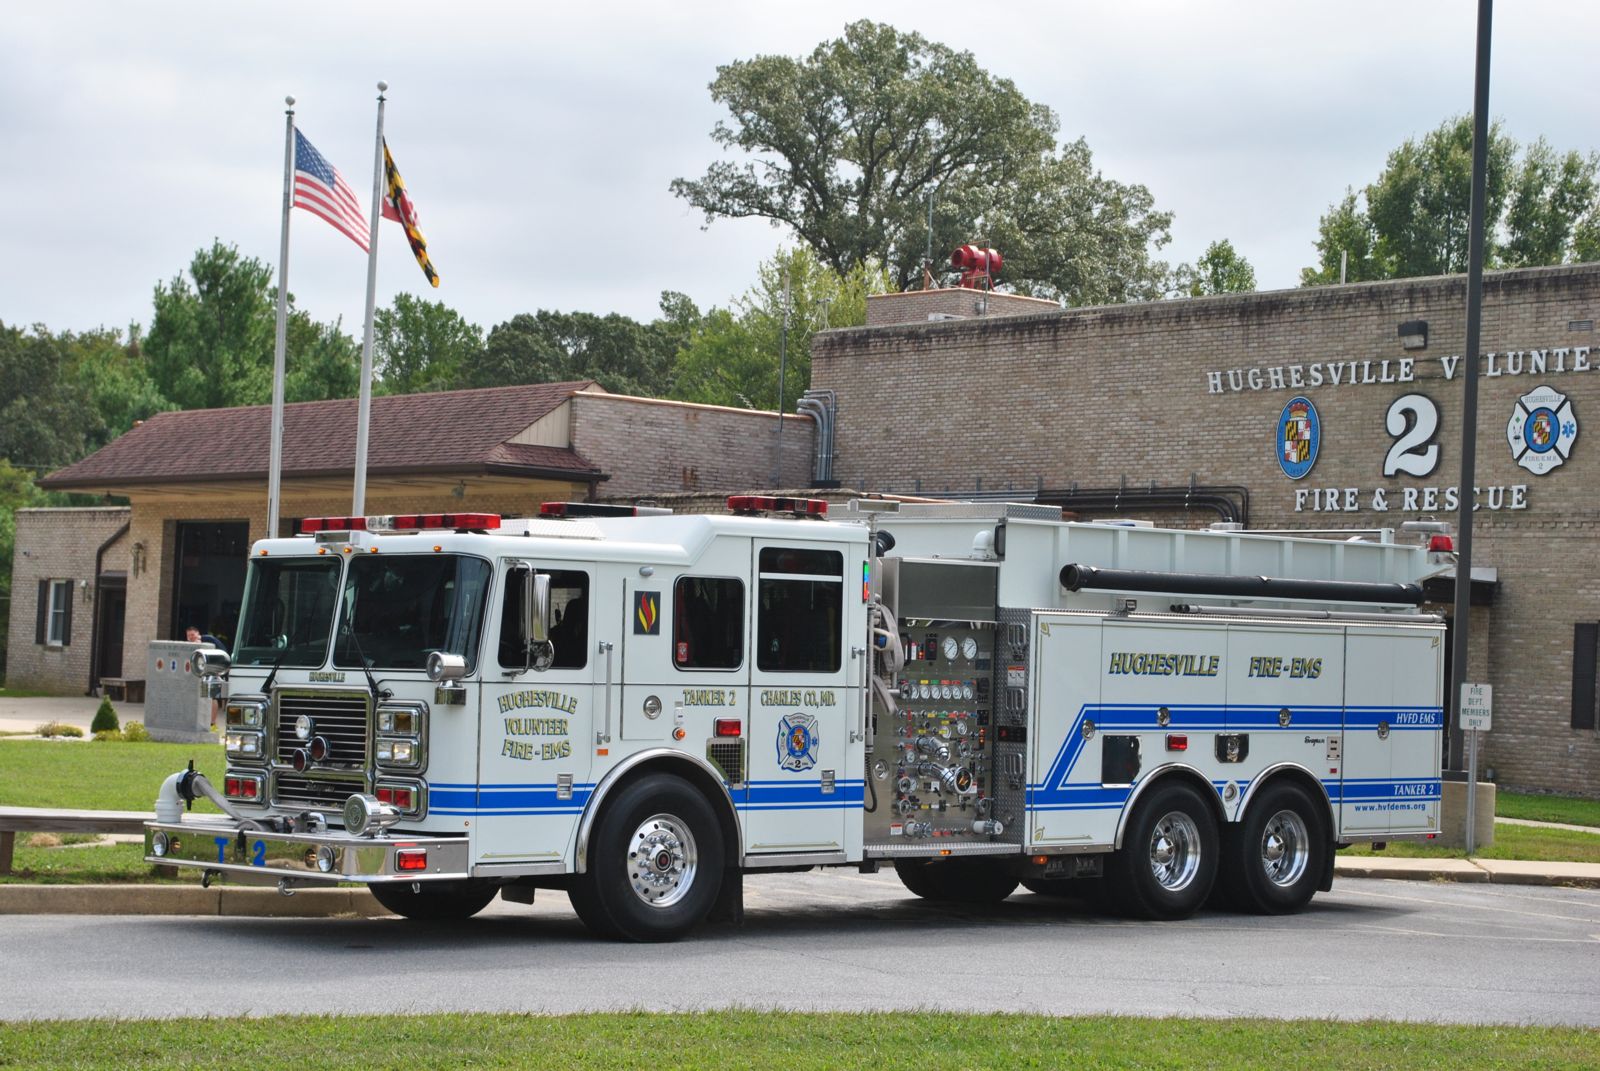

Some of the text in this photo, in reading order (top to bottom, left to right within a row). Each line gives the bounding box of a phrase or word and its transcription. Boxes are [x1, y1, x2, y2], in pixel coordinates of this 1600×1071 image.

[1207, 346, 1590, 394] HUGHESVILLE VLUNTE
[1382, 394, 1441, 478] 2
[1295, 487, 1359, 512] FIRE
[1372, 488, 1389, 511] &
[1108, 653, 1220, 676] HUGHESVILLE
[683, 689, 736, 706] TANKER 2
[760, 689, 802, 706] CHARLES
[1470, 687, 1483, 695] FIRE
[497, 690, 578, 714] HUGHESVILLE
[1396, 713, 1436, 723] HVFD EMS
[1461, 708, 1489, 716] MEMBERS
[504, 718, 568, 735] VOLUNTEER
[794, 759, 801, 768] 2
[1394, 785, 1434, 795] TANKER 2
[1355, 803, 1426, 812] www.hvfdems.org
[214, 836, 266, 866] T 2
